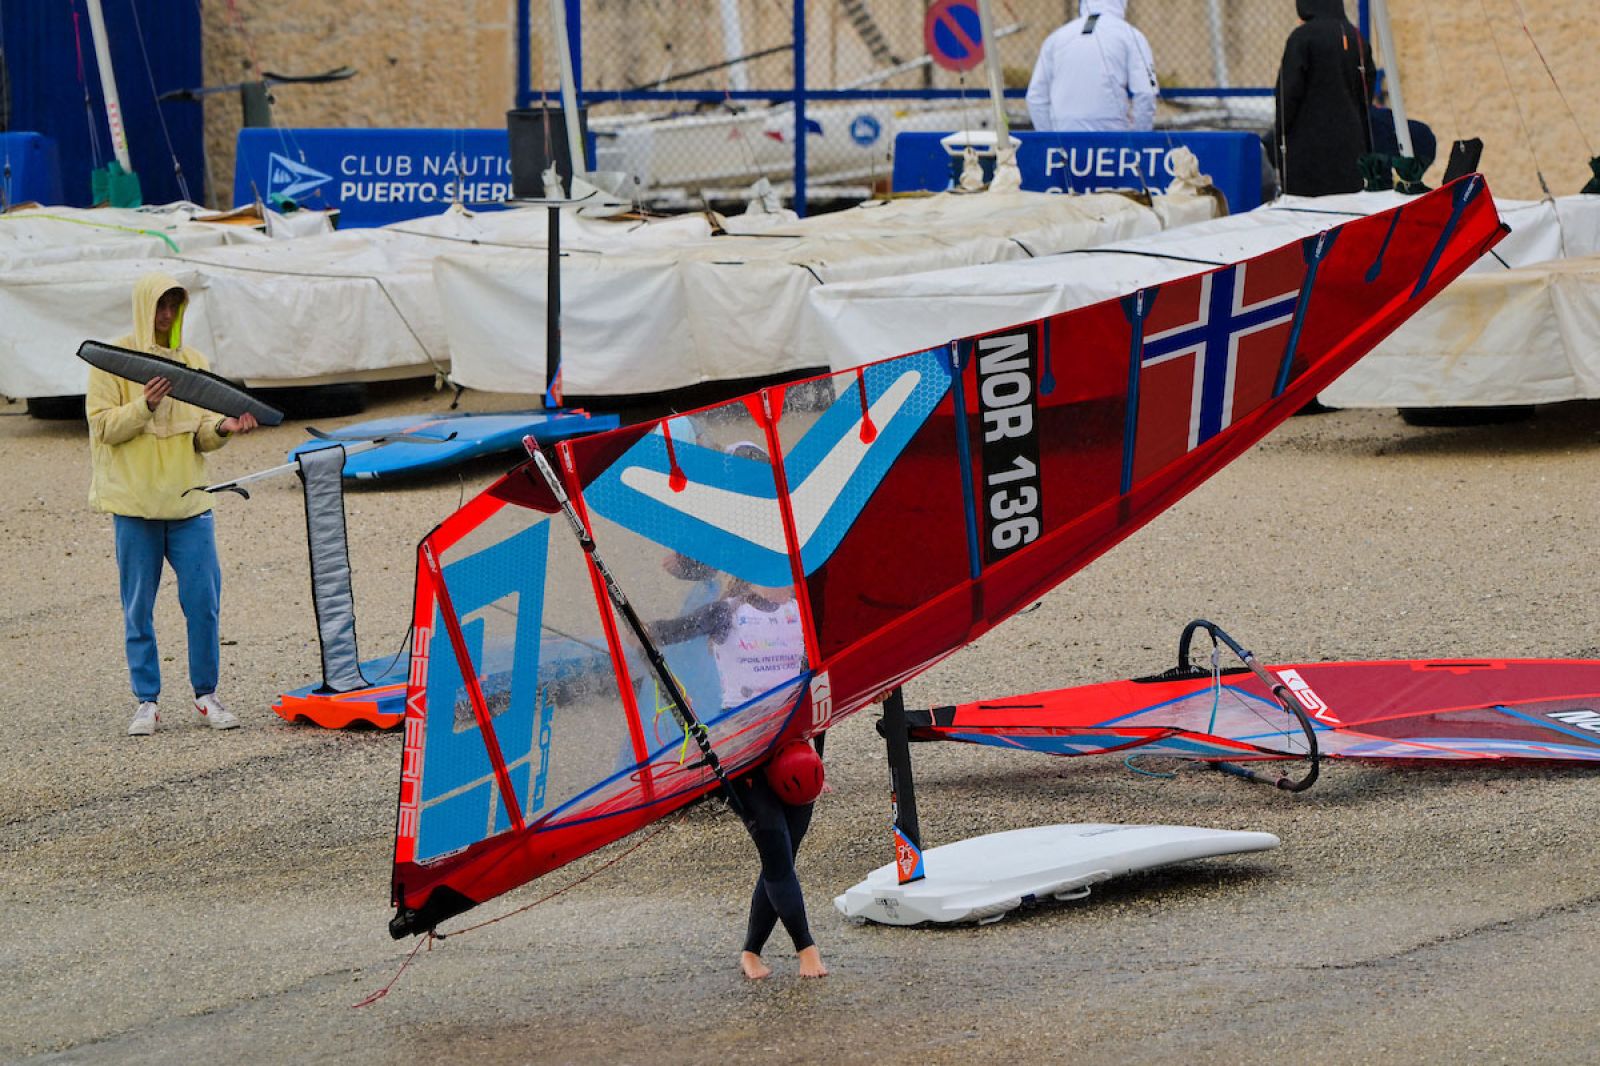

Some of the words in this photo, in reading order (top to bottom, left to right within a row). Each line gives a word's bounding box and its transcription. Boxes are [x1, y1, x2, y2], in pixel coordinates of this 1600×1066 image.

[340, 155, 413, 177] CLUB
[340, 182, 437, 202] PUERTO
[977, 332, 1034, 444] NOR
[987, 454, 1040, 551] 136
[397, 626, 431, 839] SEVERNE
